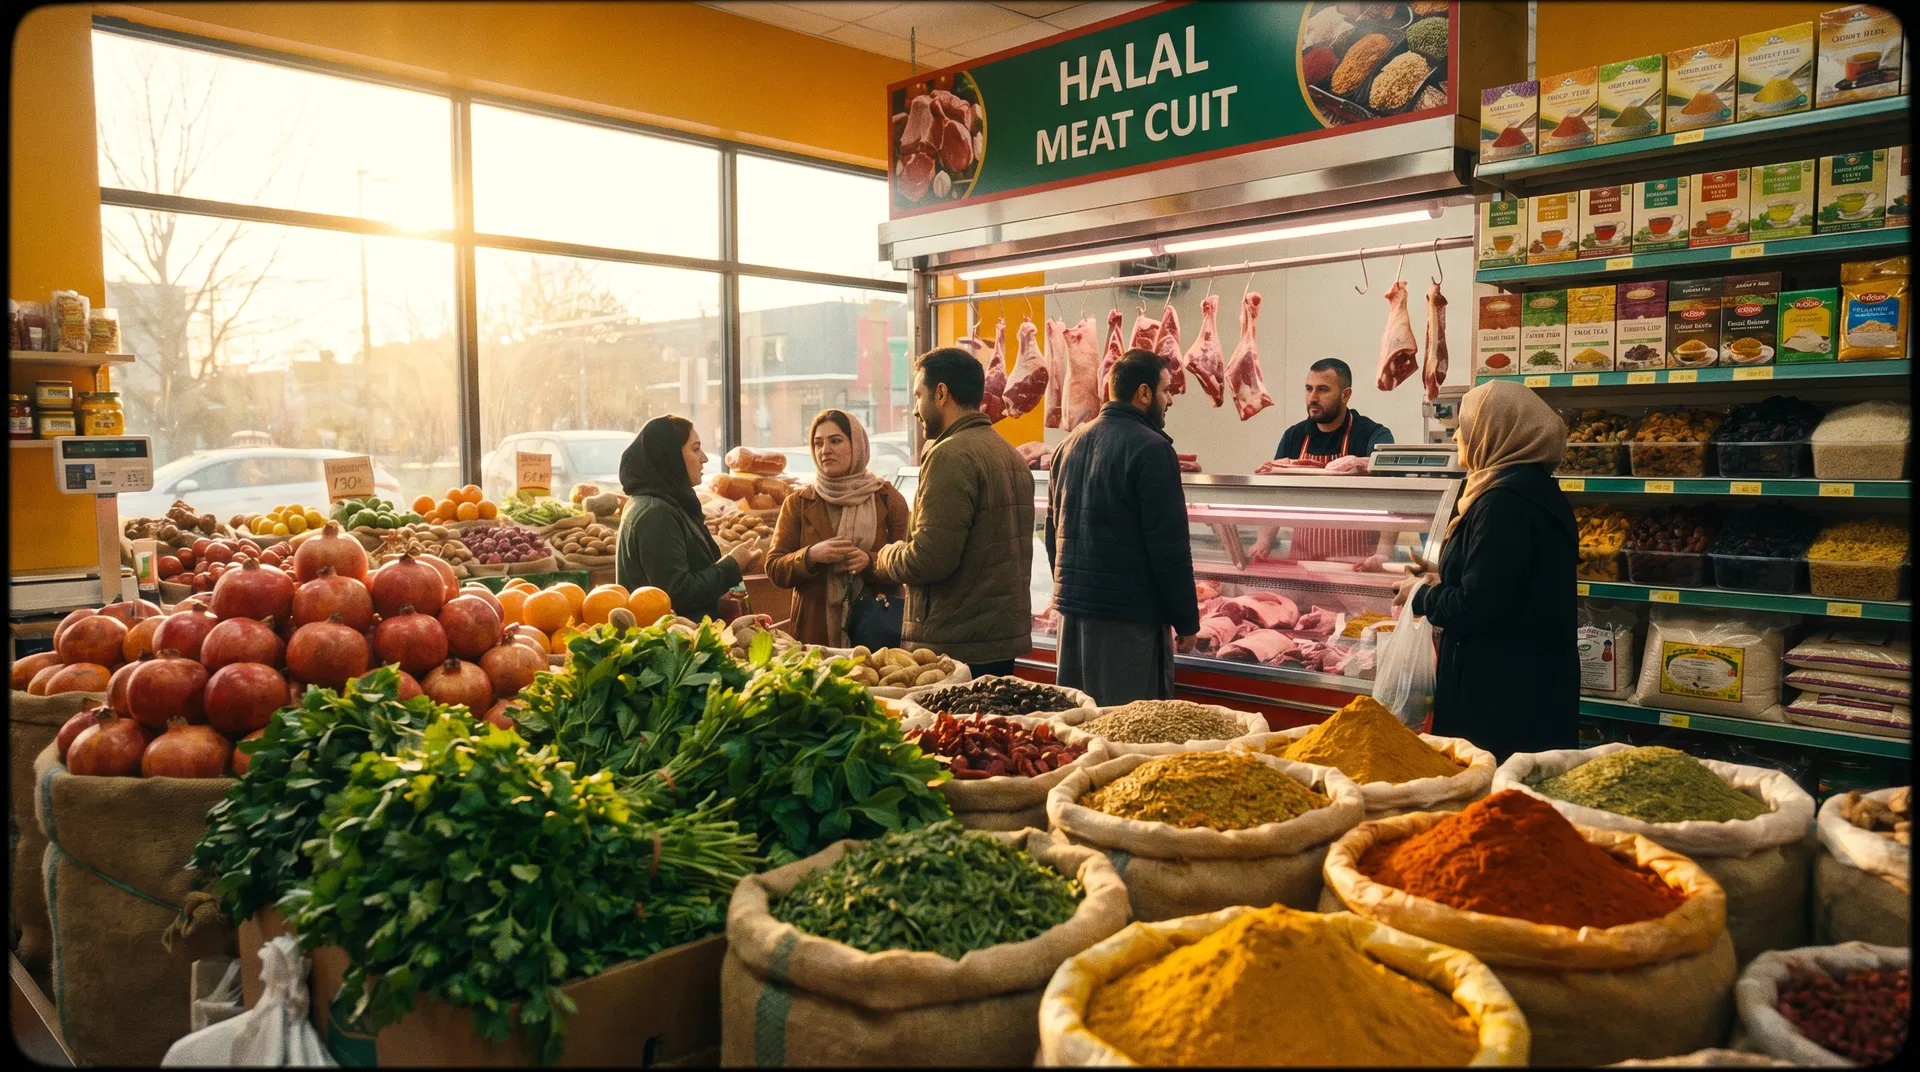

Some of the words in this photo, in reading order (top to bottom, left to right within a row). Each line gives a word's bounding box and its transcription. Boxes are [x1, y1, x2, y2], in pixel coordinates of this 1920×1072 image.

[1060, 25, 1209, 106] HALAL
[1036, 109, 1134, 165] MEAT
[1144, 85, 1238, 142] CUIT
